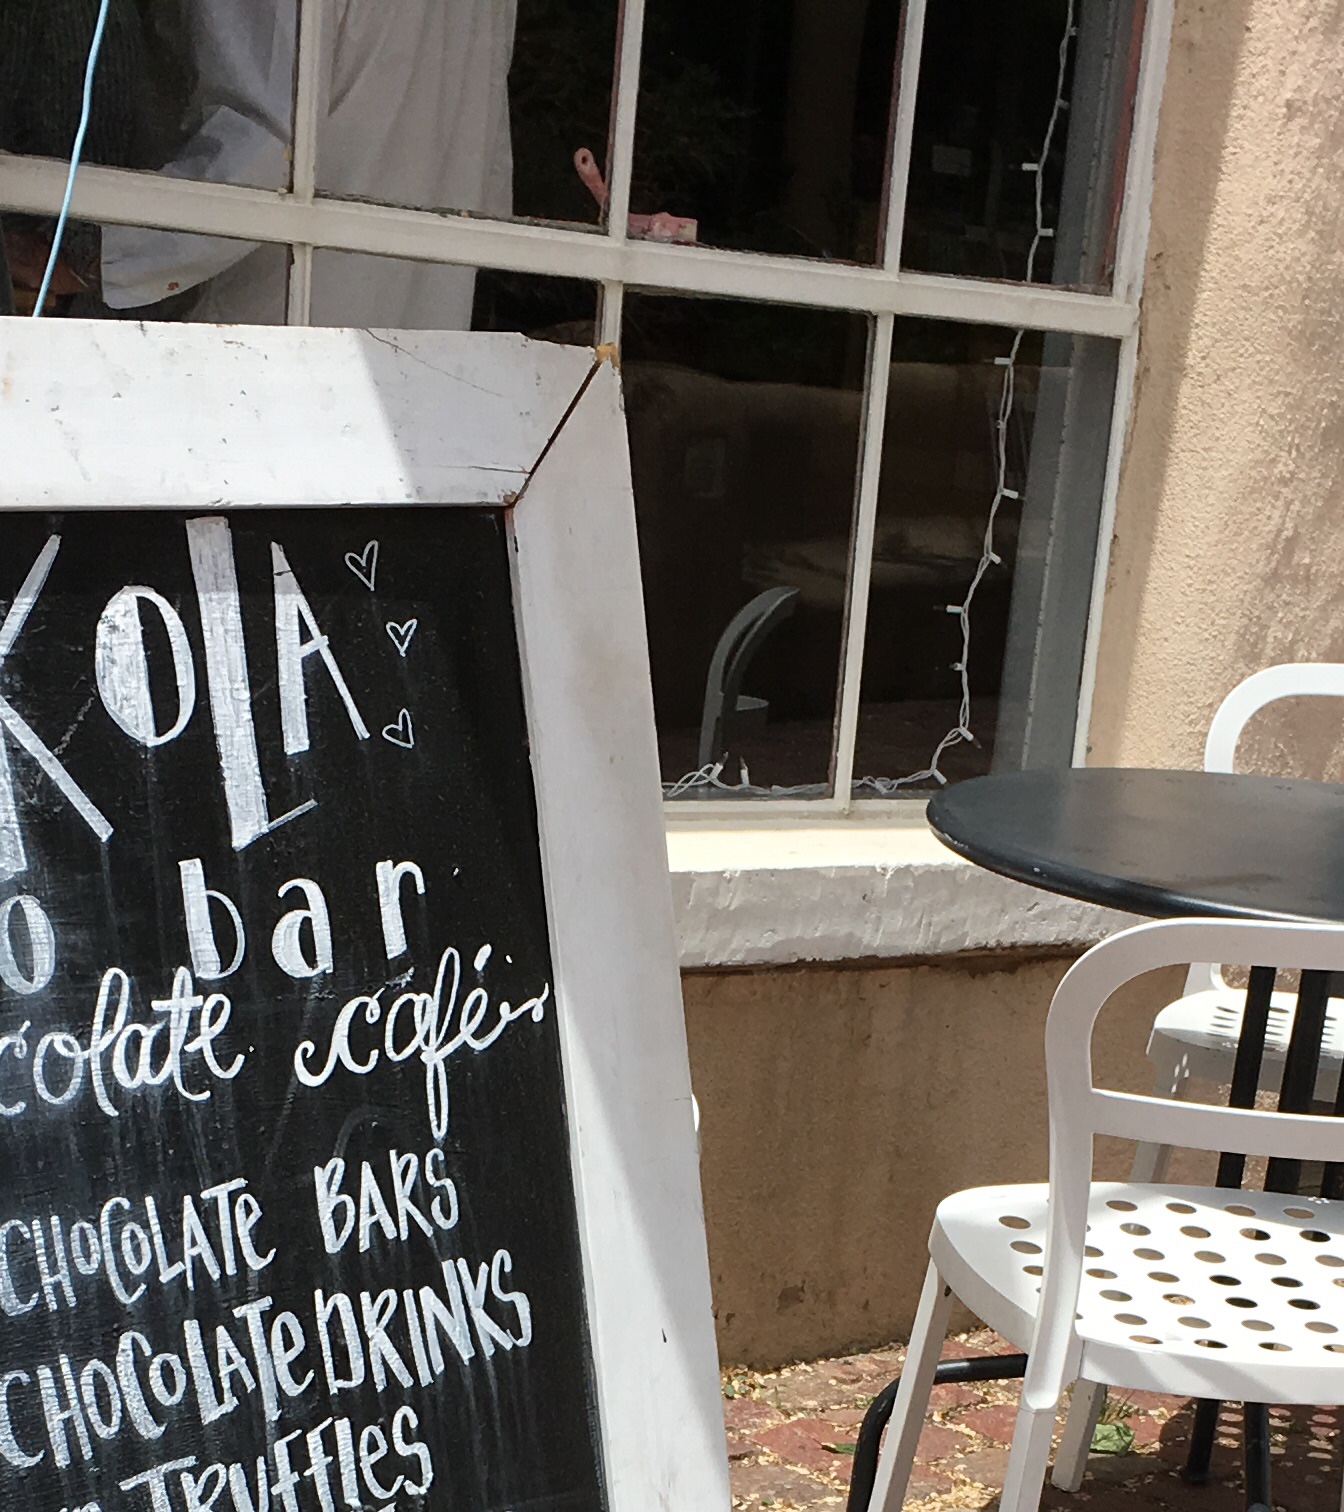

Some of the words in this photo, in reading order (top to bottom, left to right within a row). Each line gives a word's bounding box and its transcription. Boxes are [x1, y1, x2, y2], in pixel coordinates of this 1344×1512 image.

[179, 858, 426, 982] bar
[313, 1148, 459, 1255] BARS
[313, 1249, 532, 1396] DRINKS
